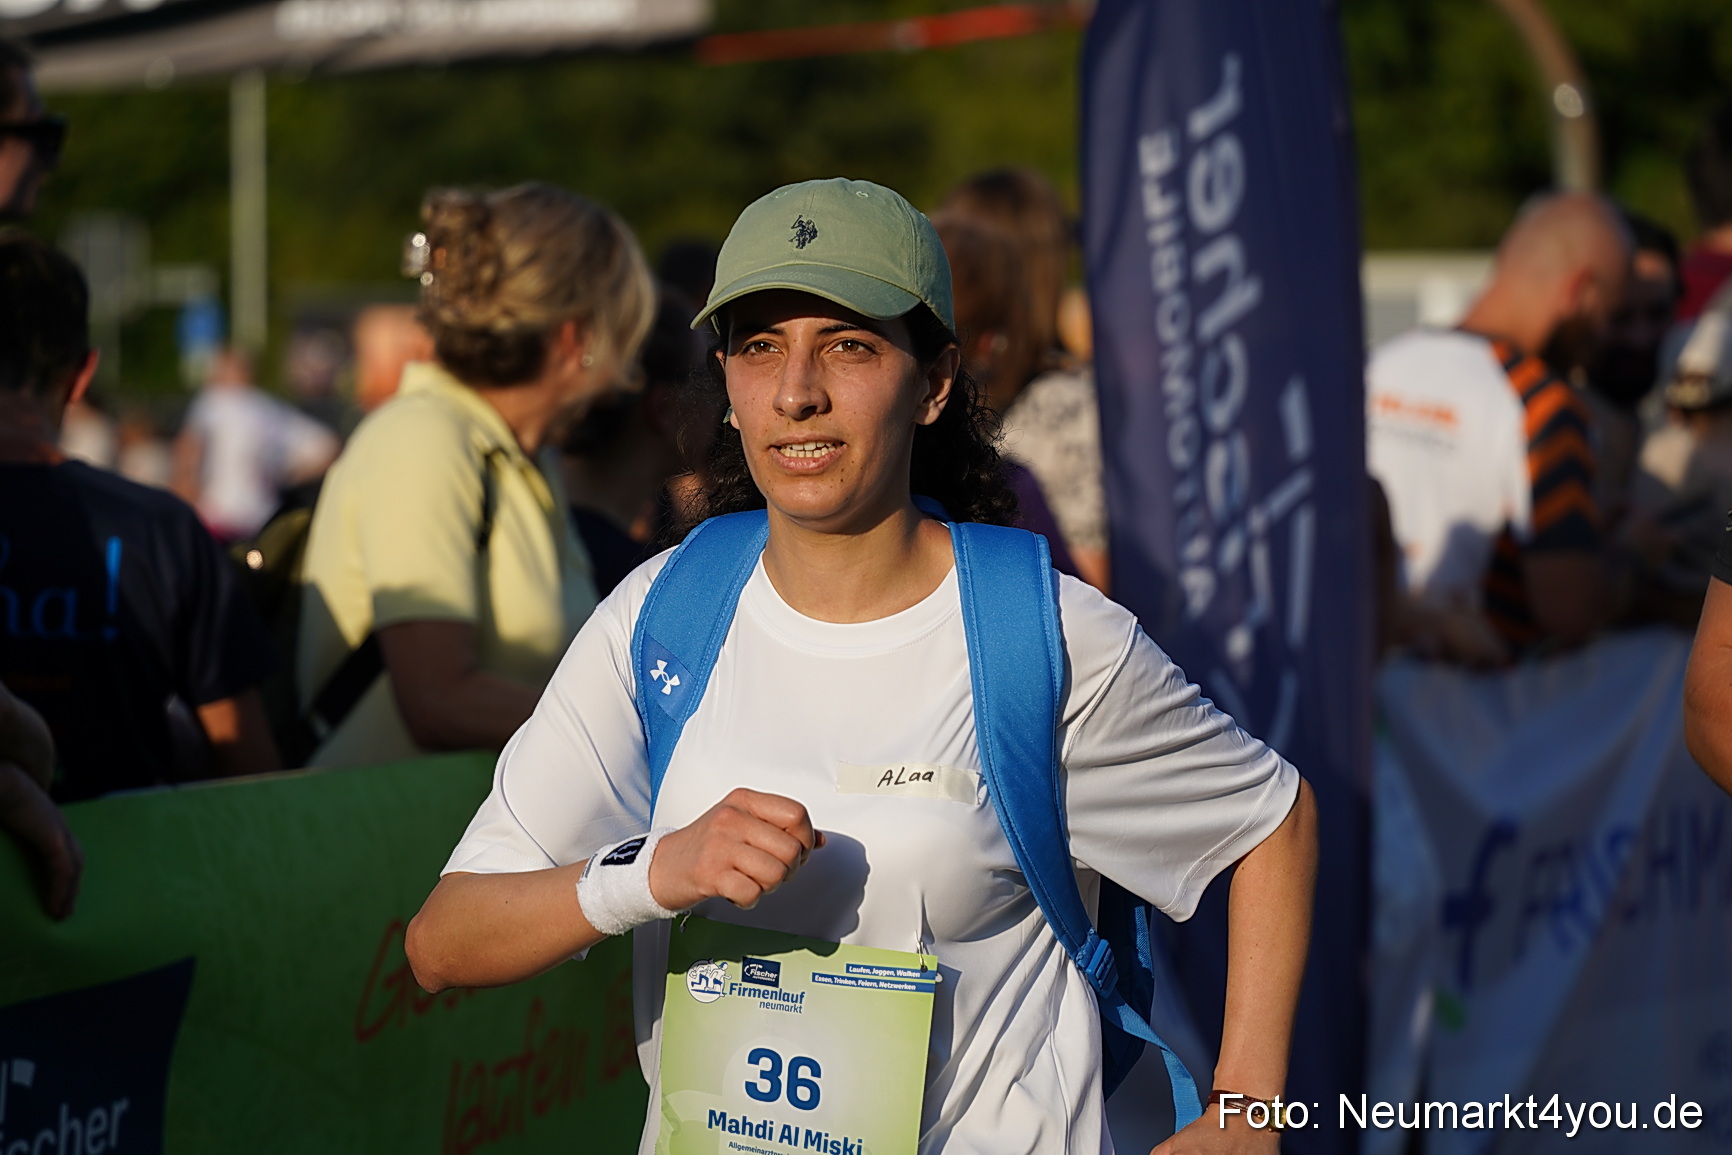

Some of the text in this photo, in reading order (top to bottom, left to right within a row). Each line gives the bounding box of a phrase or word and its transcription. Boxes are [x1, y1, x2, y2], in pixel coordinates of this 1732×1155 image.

[896, 969, 921, 978] Walken
[729, 982, 806, 1004] Firmenlauf
[878, 981, 917, 991] Netzwerken
[759, 1001, 803, 1014] neumarkt
[745, 1047, 822, 1111] 36
[707, 1109, 863, 1155] Mahdi Al Miski
